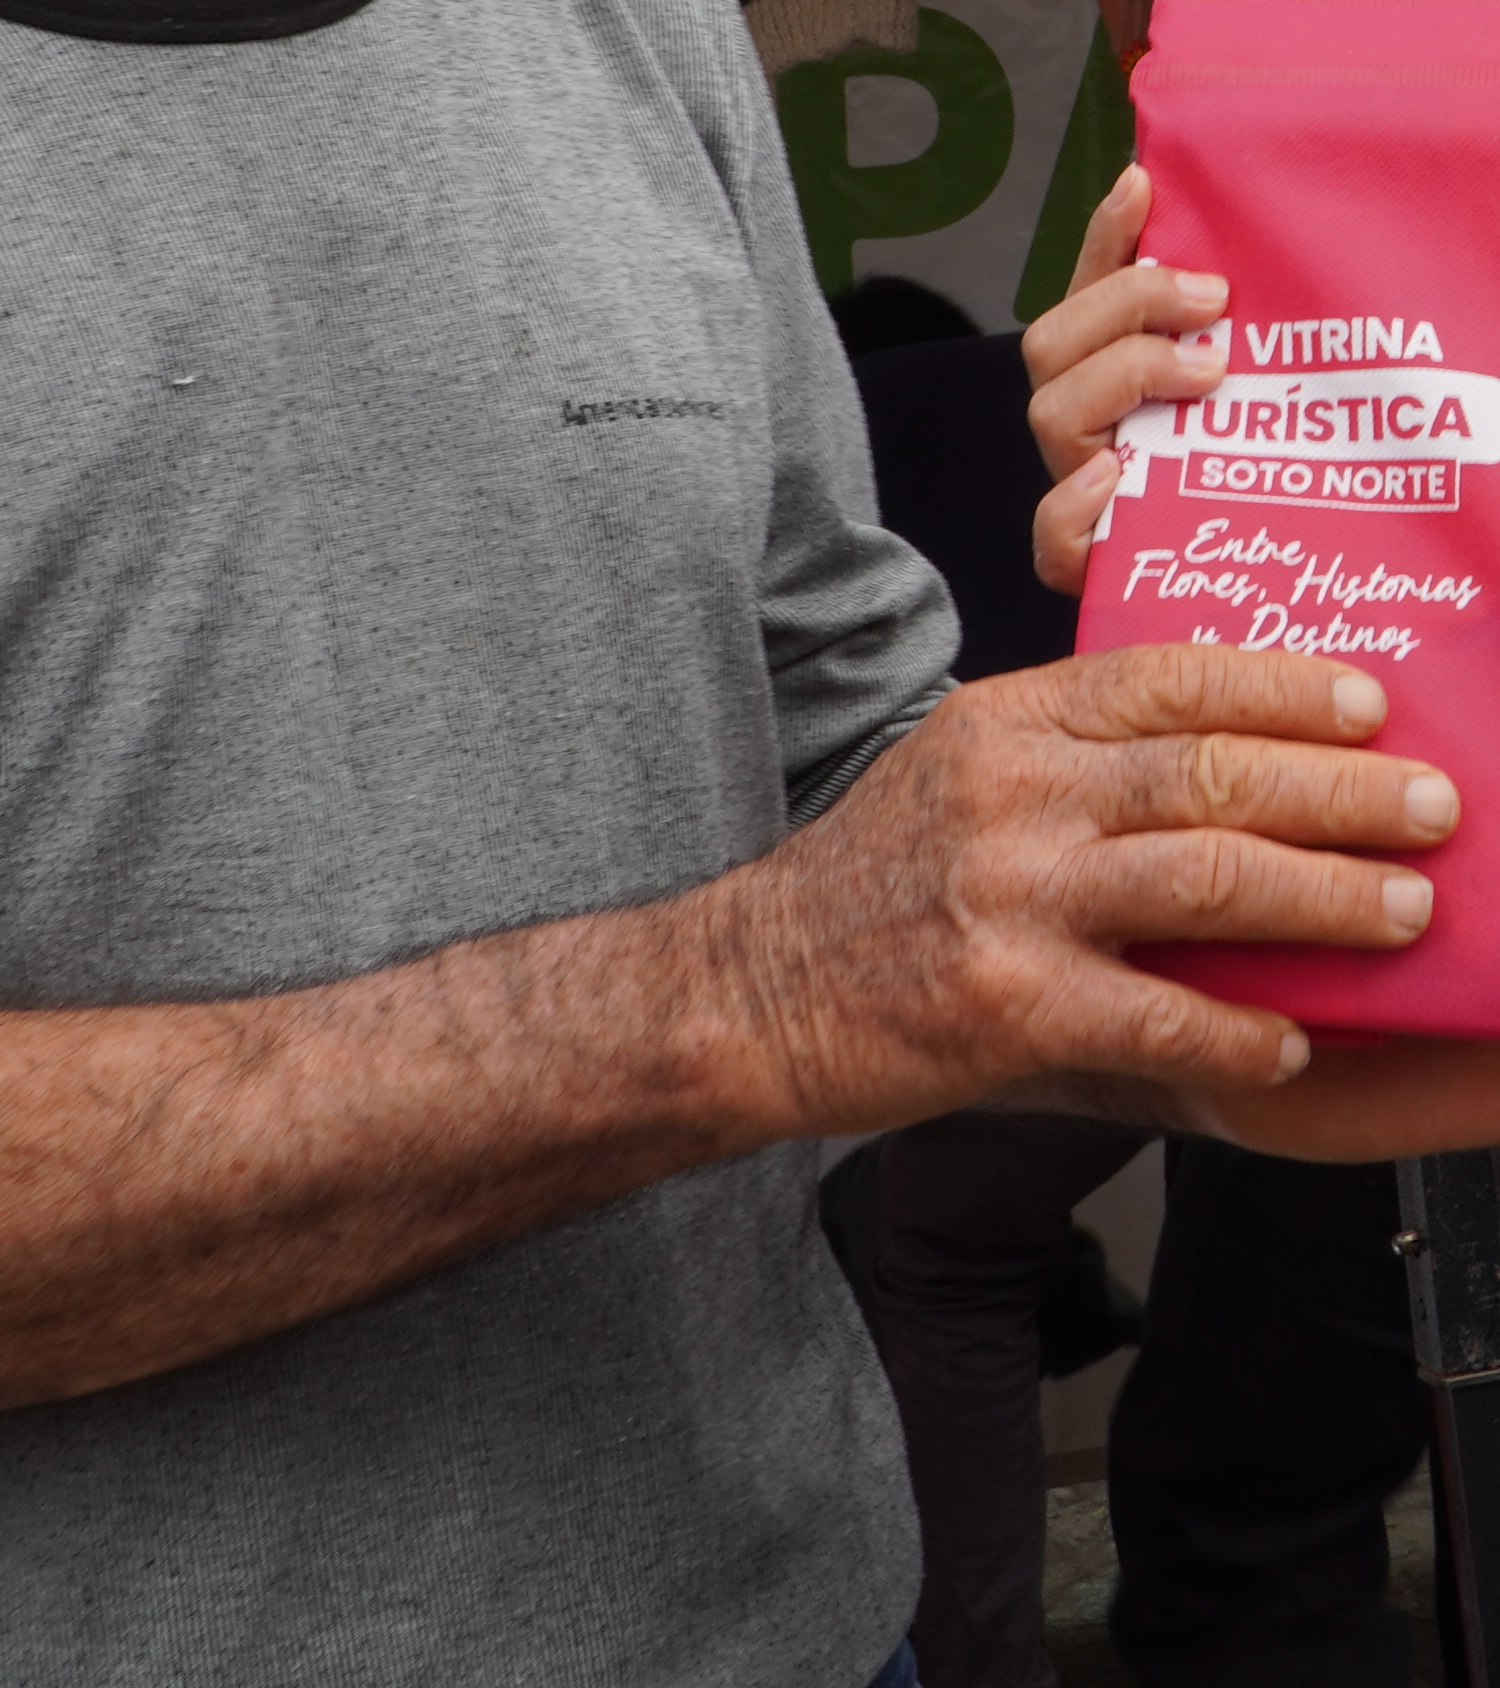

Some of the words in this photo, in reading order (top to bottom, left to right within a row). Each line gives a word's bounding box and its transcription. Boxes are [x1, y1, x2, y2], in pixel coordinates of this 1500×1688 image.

[1245, 316, 1444, 367] VITRINA
[1170, 382, 1473, 444] TURÍSTICA
[1199, 456, 1315, 498] SOTO
[1321, 463, 1448, 501] NORTE
[1183, 517, 1306, 567] Entre
[1121, 548, 1268, 608] Flores,
[1288, 552, 1483, 610] Historias
[1238, 603, 1423, 661] Destinos
